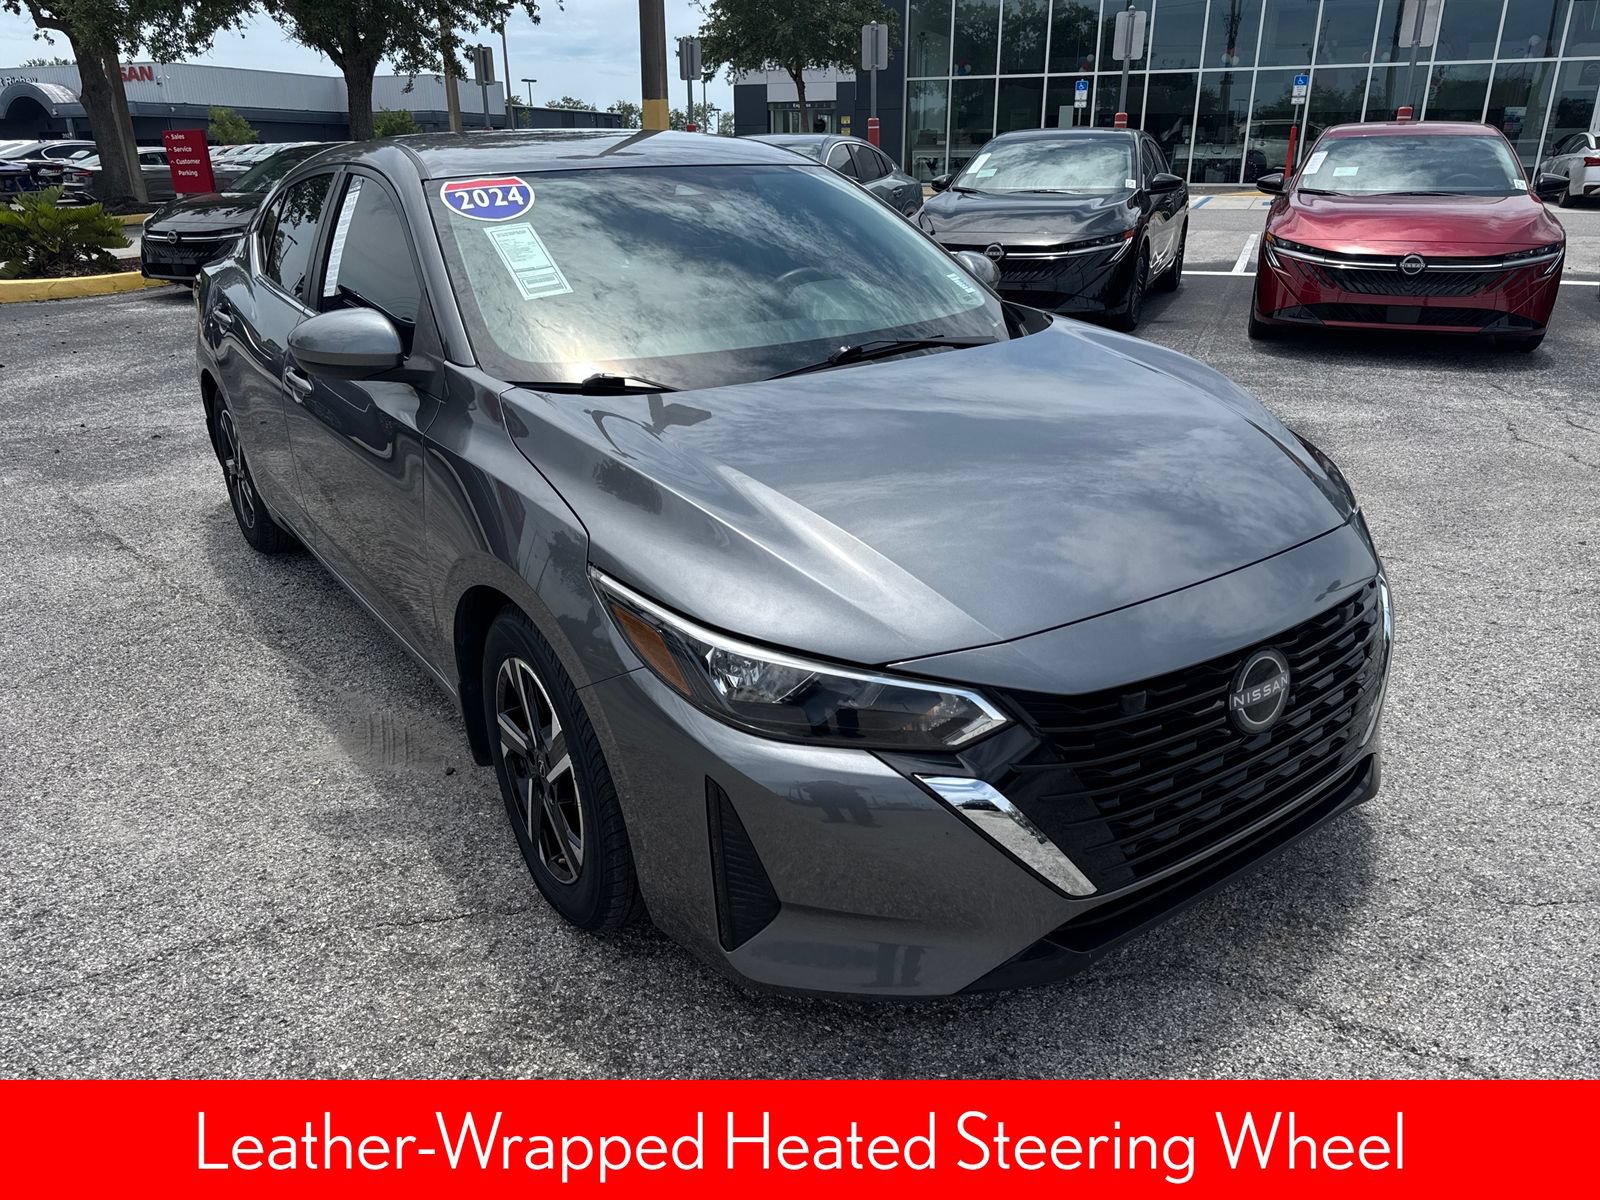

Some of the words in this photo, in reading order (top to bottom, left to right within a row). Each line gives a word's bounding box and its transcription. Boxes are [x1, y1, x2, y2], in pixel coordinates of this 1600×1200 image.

[120, 66, 154, 81] SAN
[178, 169, 198, 177] Parking
[454, 186, 524, 210] 2024
[1233, 675, 1288, 707] NISSAN
